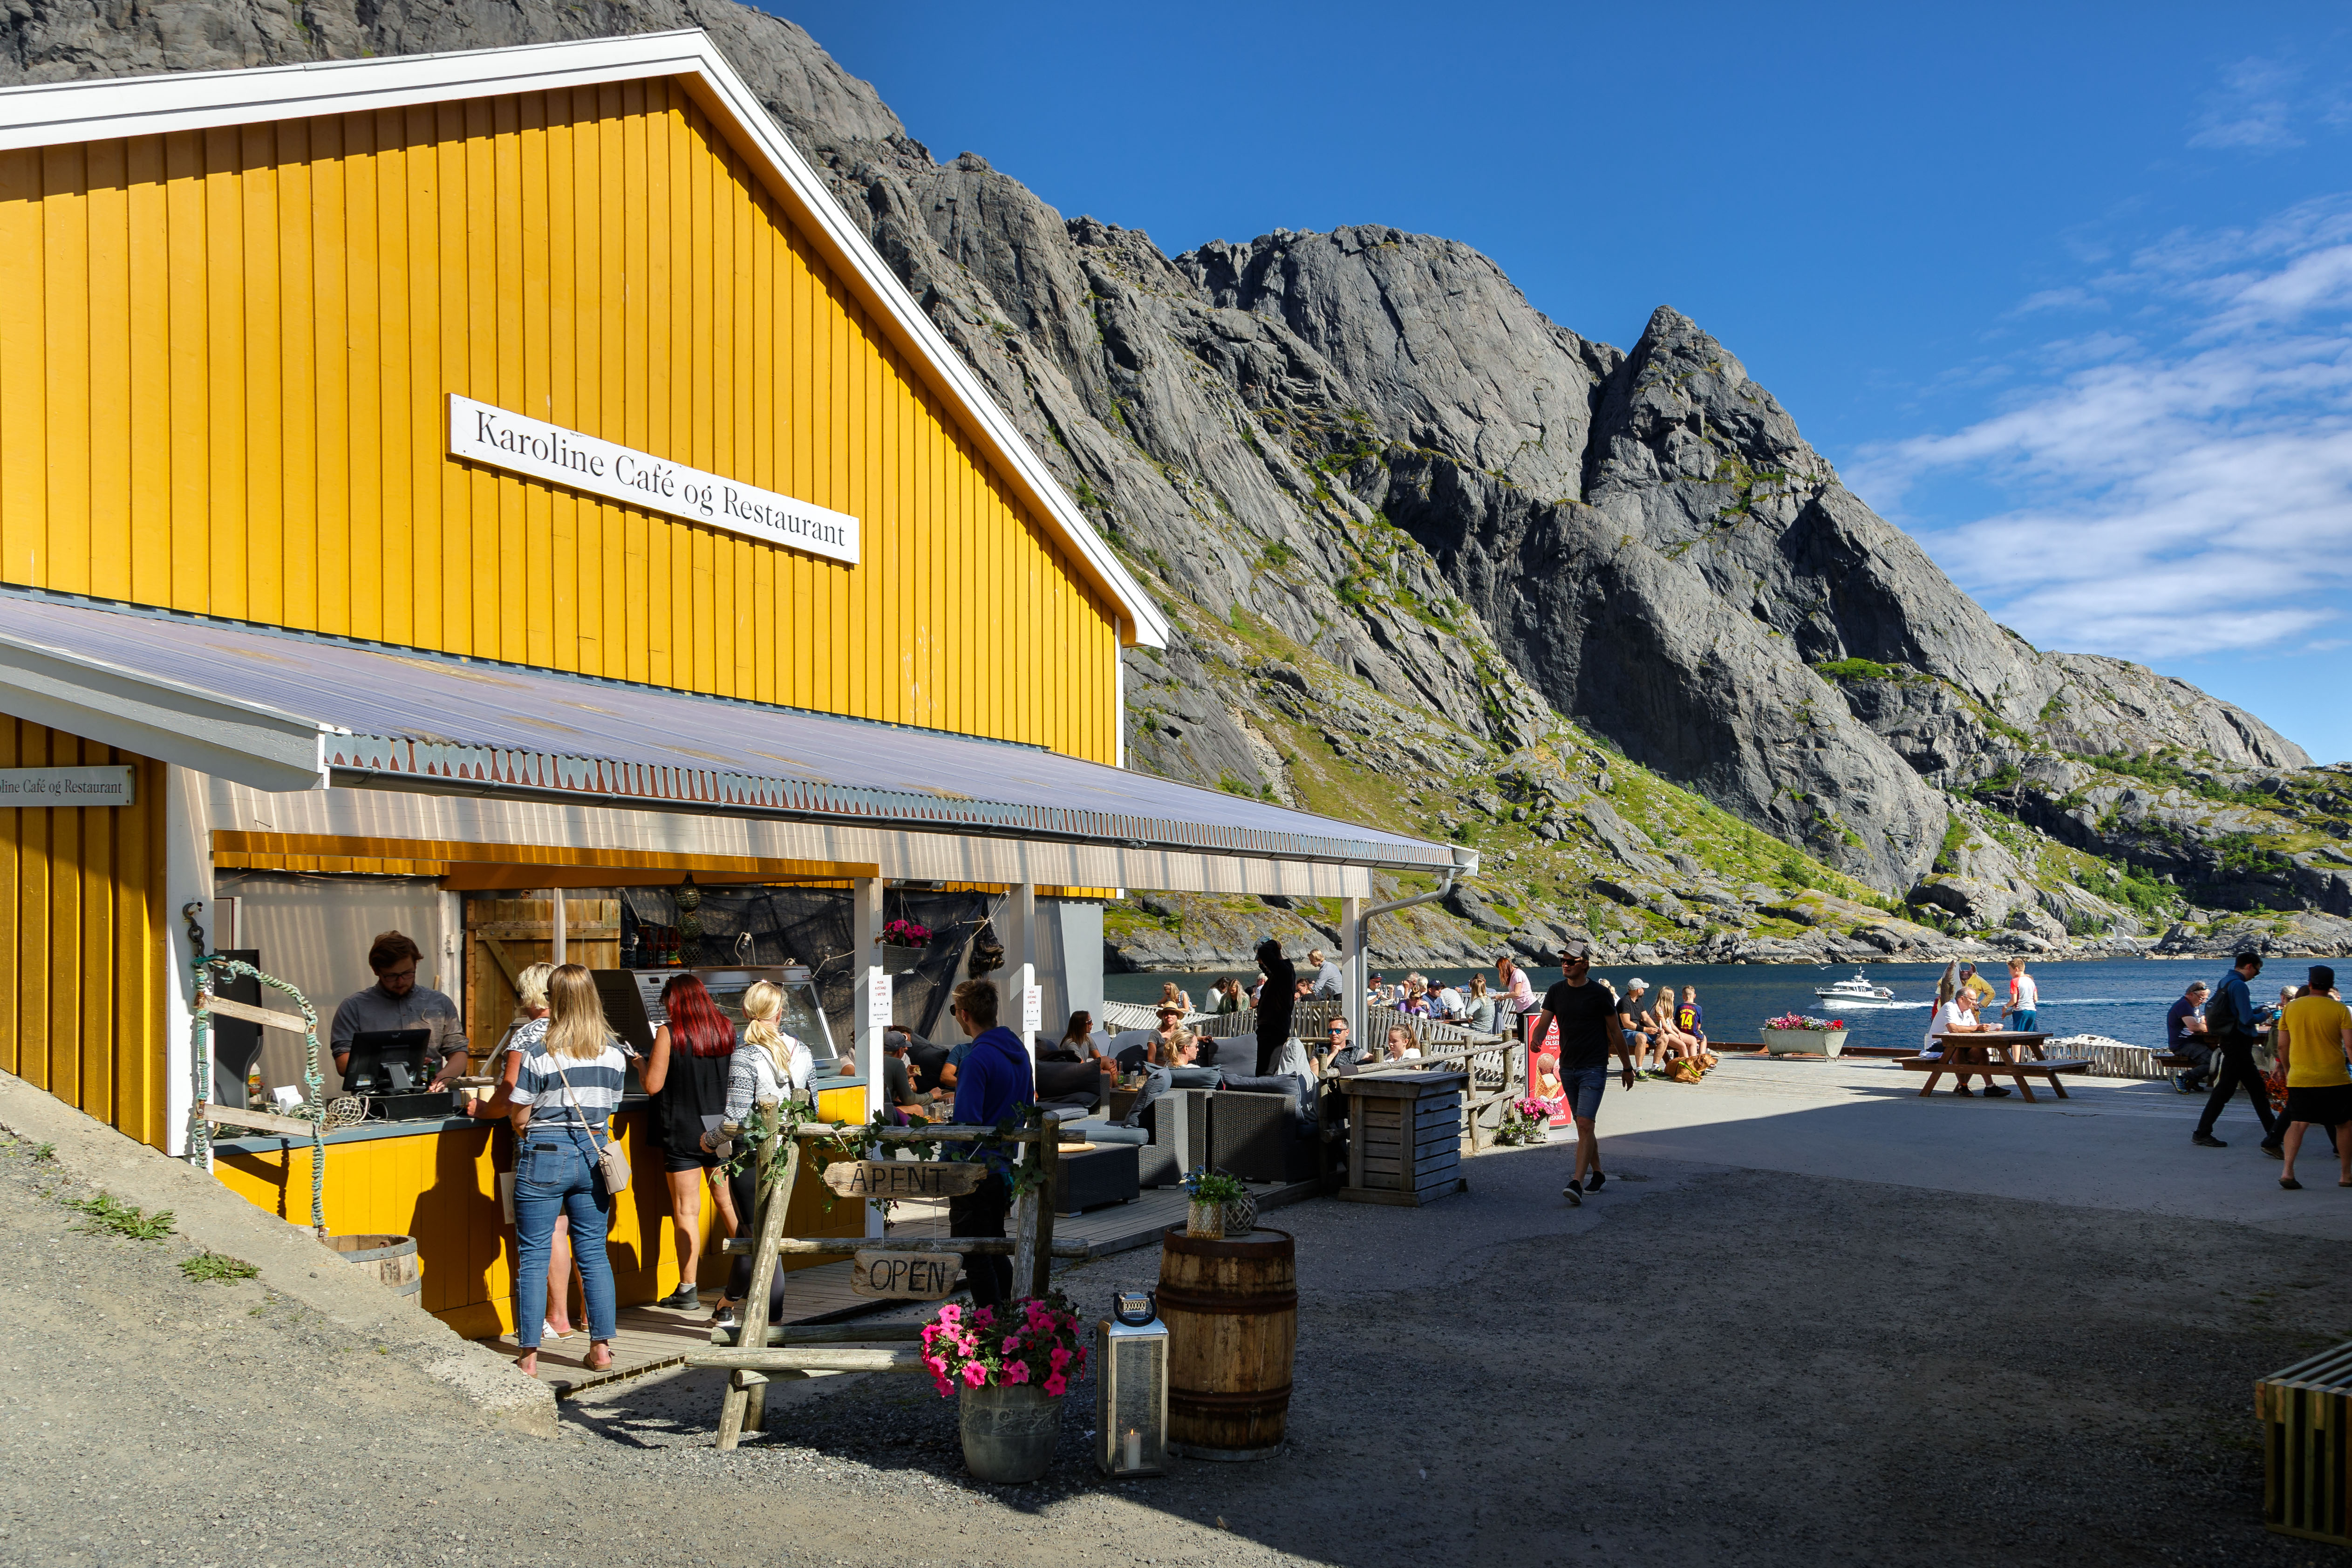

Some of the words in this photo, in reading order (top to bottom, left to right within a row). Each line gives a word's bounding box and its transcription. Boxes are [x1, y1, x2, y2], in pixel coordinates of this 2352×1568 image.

[475, 410, 604, 477] Karoline
[615, 455, 674, 497] Café
[684, 476, 714, 516] og
[723, 486, 846, 546] Restaurant
[23, 778, 46, 793] Café
[48, 781, 61, 796] og
[65, 779, 123, 794] Restaurant
[1681, 1013, 1693, 1027] 14
[849, 1163, 948, 1193] ÅPENT
[869, 1259, 945, 1293] OPEN
